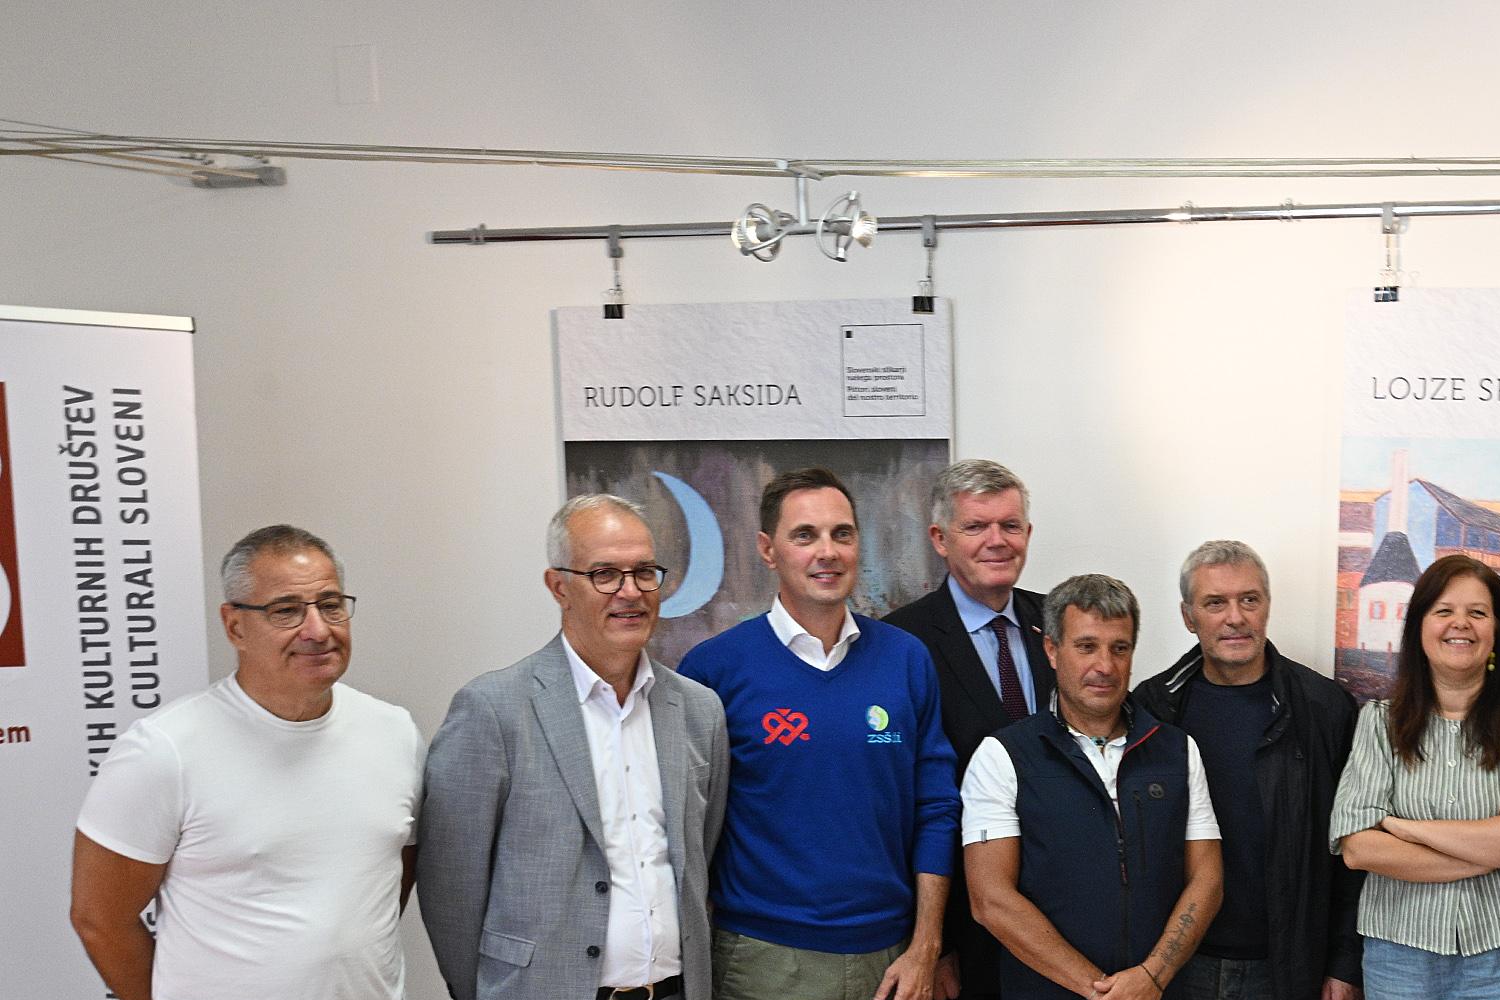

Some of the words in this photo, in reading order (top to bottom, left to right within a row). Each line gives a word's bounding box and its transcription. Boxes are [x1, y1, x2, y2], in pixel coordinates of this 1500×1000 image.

[58, 384, 103, 525] DRUŠTEV
[112, 387, 150, 525] SLOVENI
[583, 385, 685, 408] RUDOLF
[693, 384, 803, 407] SAKSIDA
[1371, 376, 1466, 401] LOJZE
[74, 537, 115, 710] KULTURNIH
[122, 538, 162, 710] CULTURALI
